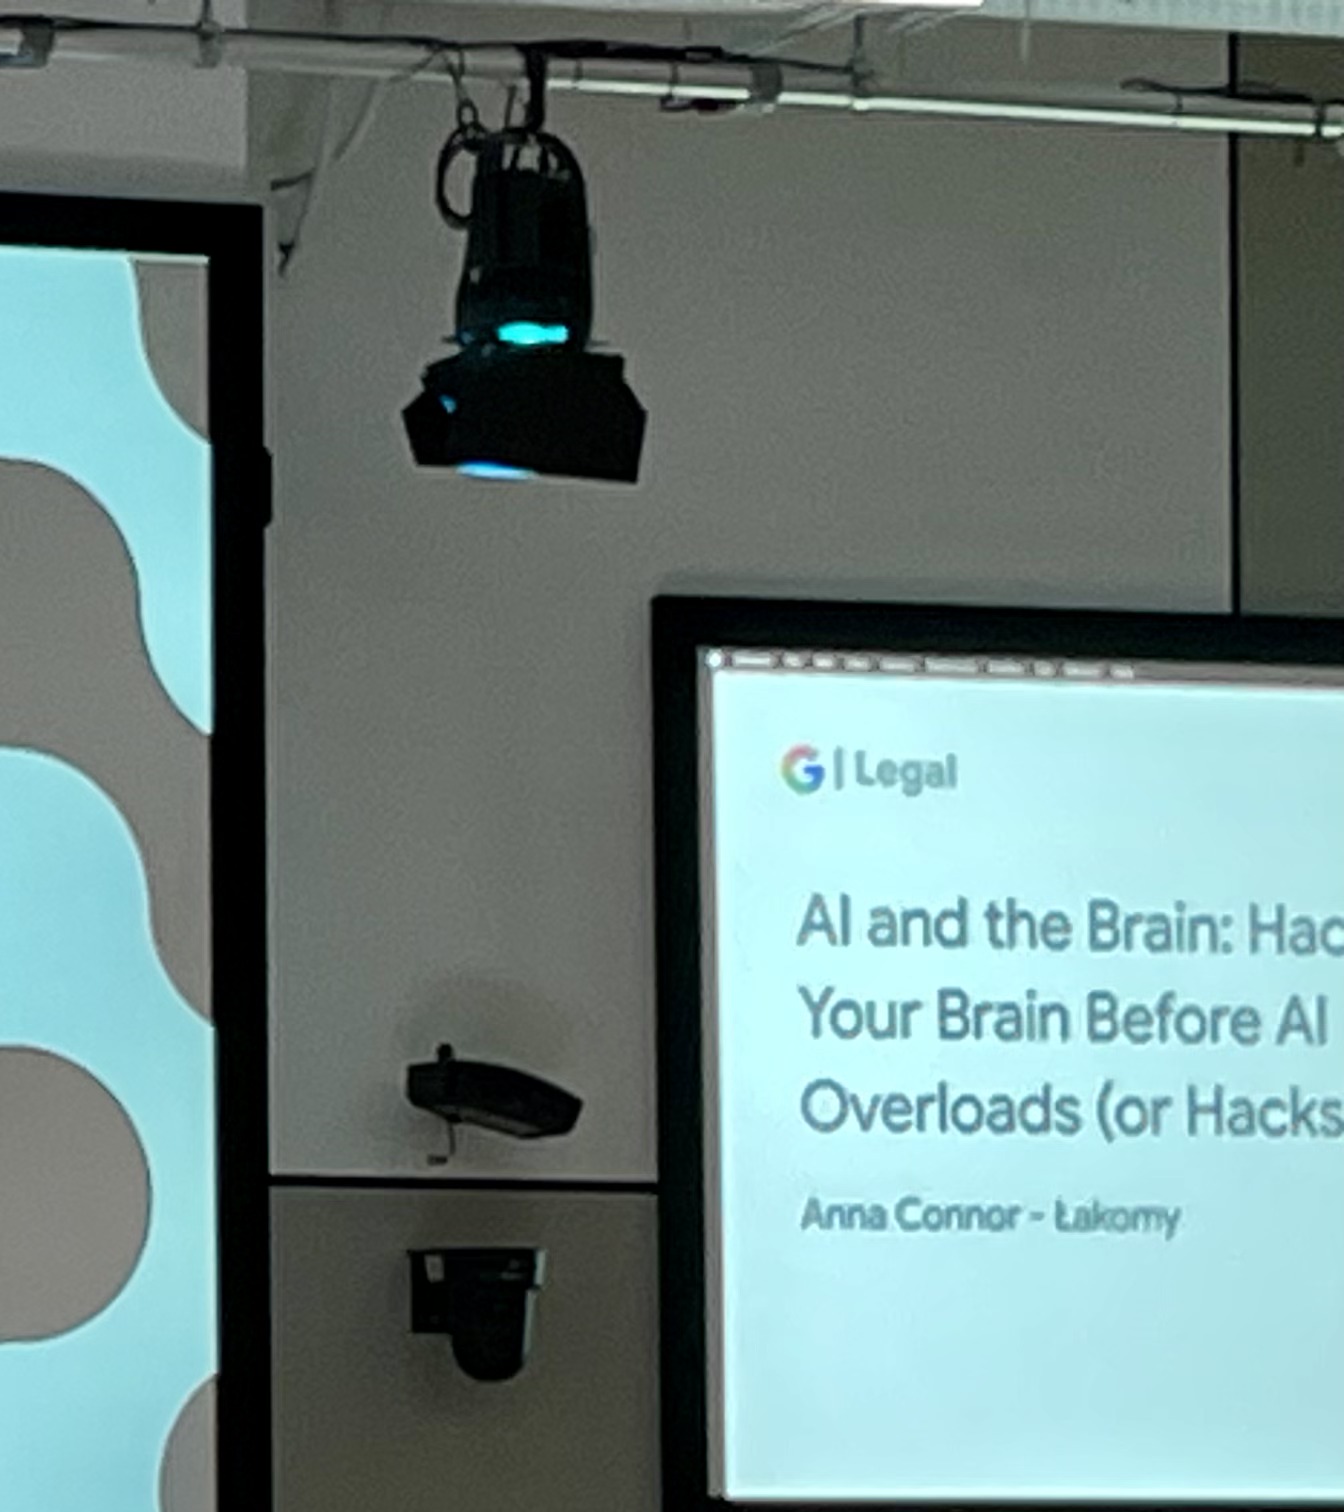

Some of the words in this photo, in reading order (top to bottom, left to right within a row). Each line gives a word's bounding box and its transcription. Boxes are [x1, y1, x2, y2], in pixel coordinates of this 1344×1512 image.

[853, 748, 959, 799] Legal
[795, 891, 852, 948] AI
[866, 895, 970, 950] and
[982, 895, 1074, 953] the
[1087, 897, 1234, 955] Brain:
[796, 984, 924, 1042] Your
[936, 986, 1072, 1044] Brain
[1085, 988, 1263, 1047] Before
[1274, 993, 1329, 1047] AI
[799, 1077, 1084, 1137] Overloads
[1095, 1078, 1174, 1145] (or
[799, 1196, 889, 1232] Anna
[893, 1194, 1024, 1234] Connor
